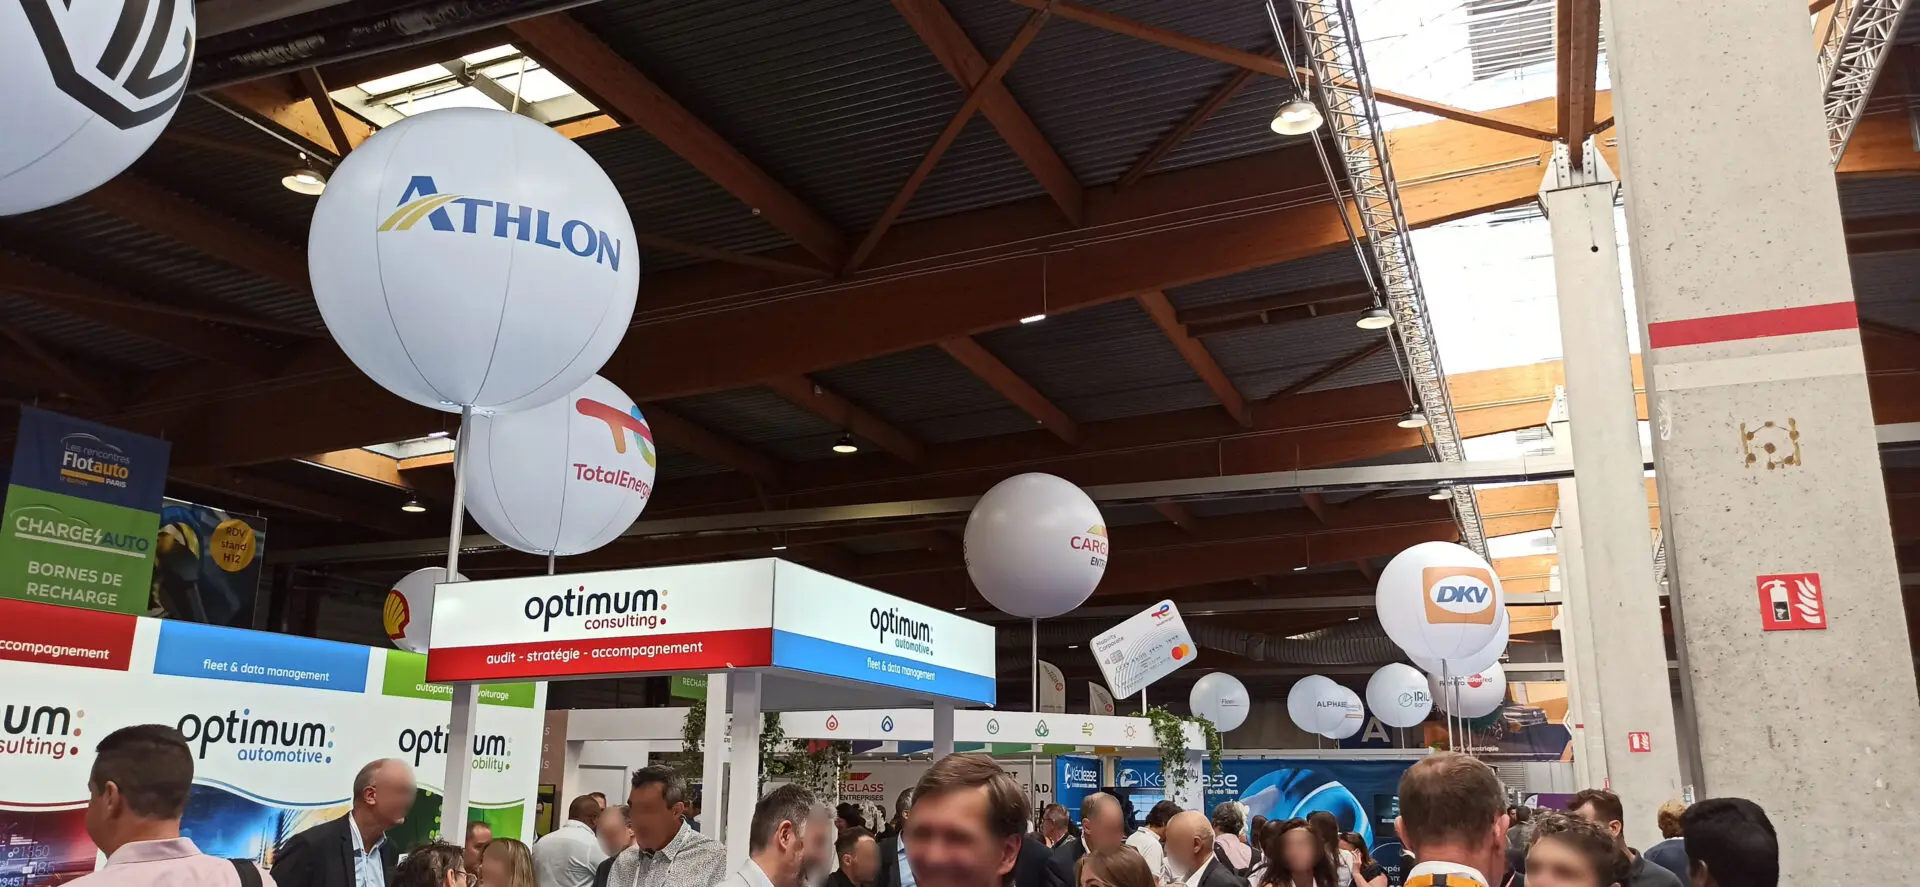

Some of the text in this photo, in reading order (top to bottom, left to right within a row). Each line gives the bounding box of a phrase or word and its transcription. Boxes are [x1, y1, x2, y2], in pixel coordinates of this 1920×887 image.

[378, 176, 620, 272] ATHLON
[83, 447, 130, 464] rencontres
[62, 451, 129, 479] Flotauto
[105, 478, 127, 488] PARIS
[573, 463, 651, 499] TotalEnerg
[226, 526, 247, 537] RDV
[221, 540, 248, 551] stand
[223, 552, 241, 564] H12
[27, 560, 123, 587] BORNES DE
[26, 582, 118, 606] RECHARGE
[1436, 585, 1489, 603] DKV
[584, 614, 657, 630] consulting
[0, 639, 110, 660] ccompagnement
[486, 652, 516, 665] audit
[526, 647, 580, 663] stratégie
[591, 641, 703, 659] accompagnement
[895, 638, 930, 655] automotive
[203, 658, 330, 682] fleet & data management
[867, 657, 936, 681] fleet & data management
[416, 683, 453, 695] autoparta
[682, 677, 708, 688] RECHAR
[1361, 716, 1391, 742] A
[238, 747, 323, 763] automotive
[472, 757, 504, 773] obility
[839, 783, 884, 792] RGLASS
